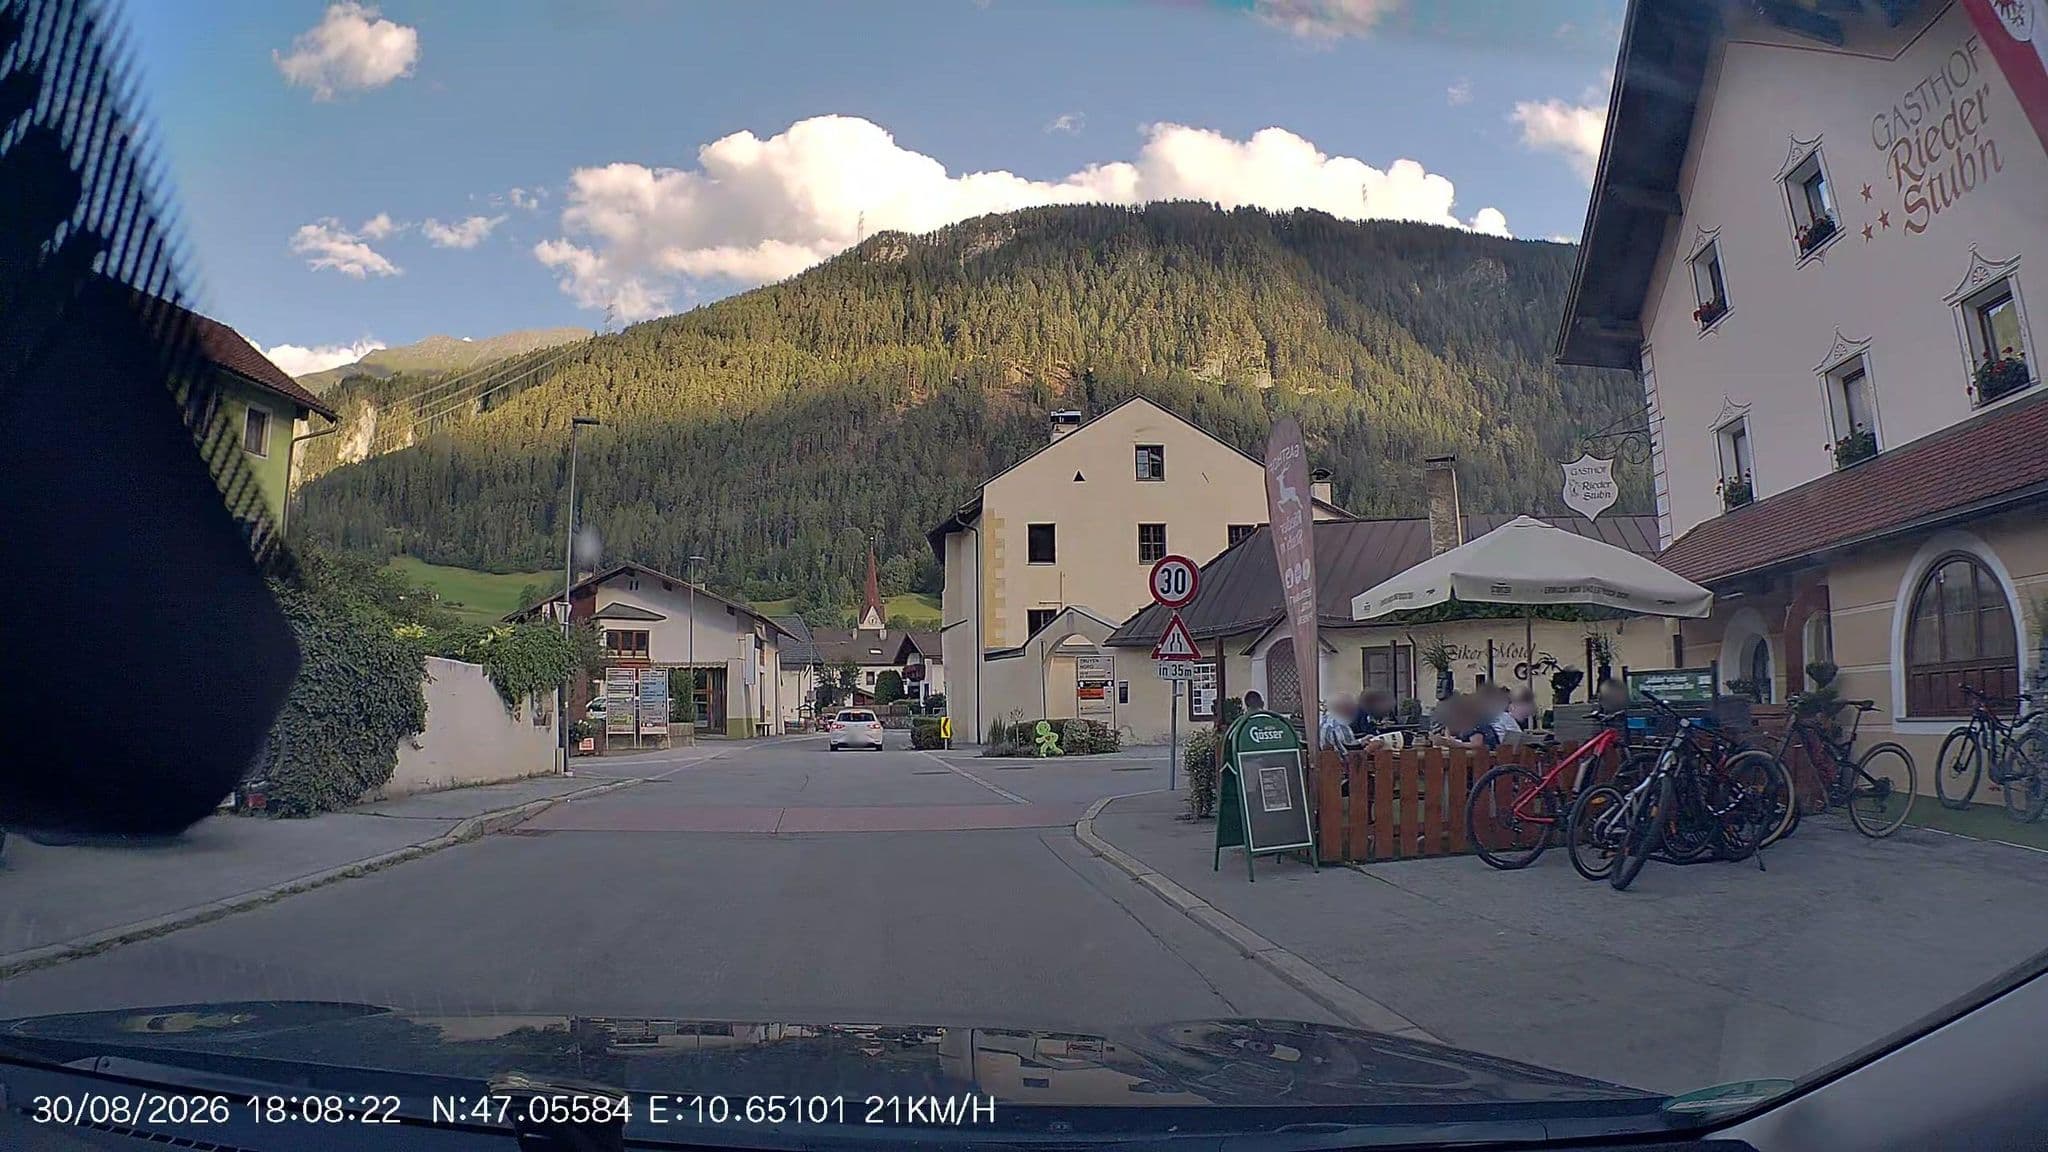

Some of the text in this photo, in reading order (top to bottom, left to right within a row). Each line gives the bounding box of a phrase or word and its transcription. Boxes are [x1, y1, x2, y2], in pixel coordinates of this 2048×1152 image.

[1872, 34, 1979, 151] GASTHOF
[1886, 83, 1990, 193] Rieder
[1904, 134, 2004, 236] Stub'n
[1160, 568, 1186, 595] 30
[1159, 664, 1168, 677] in
